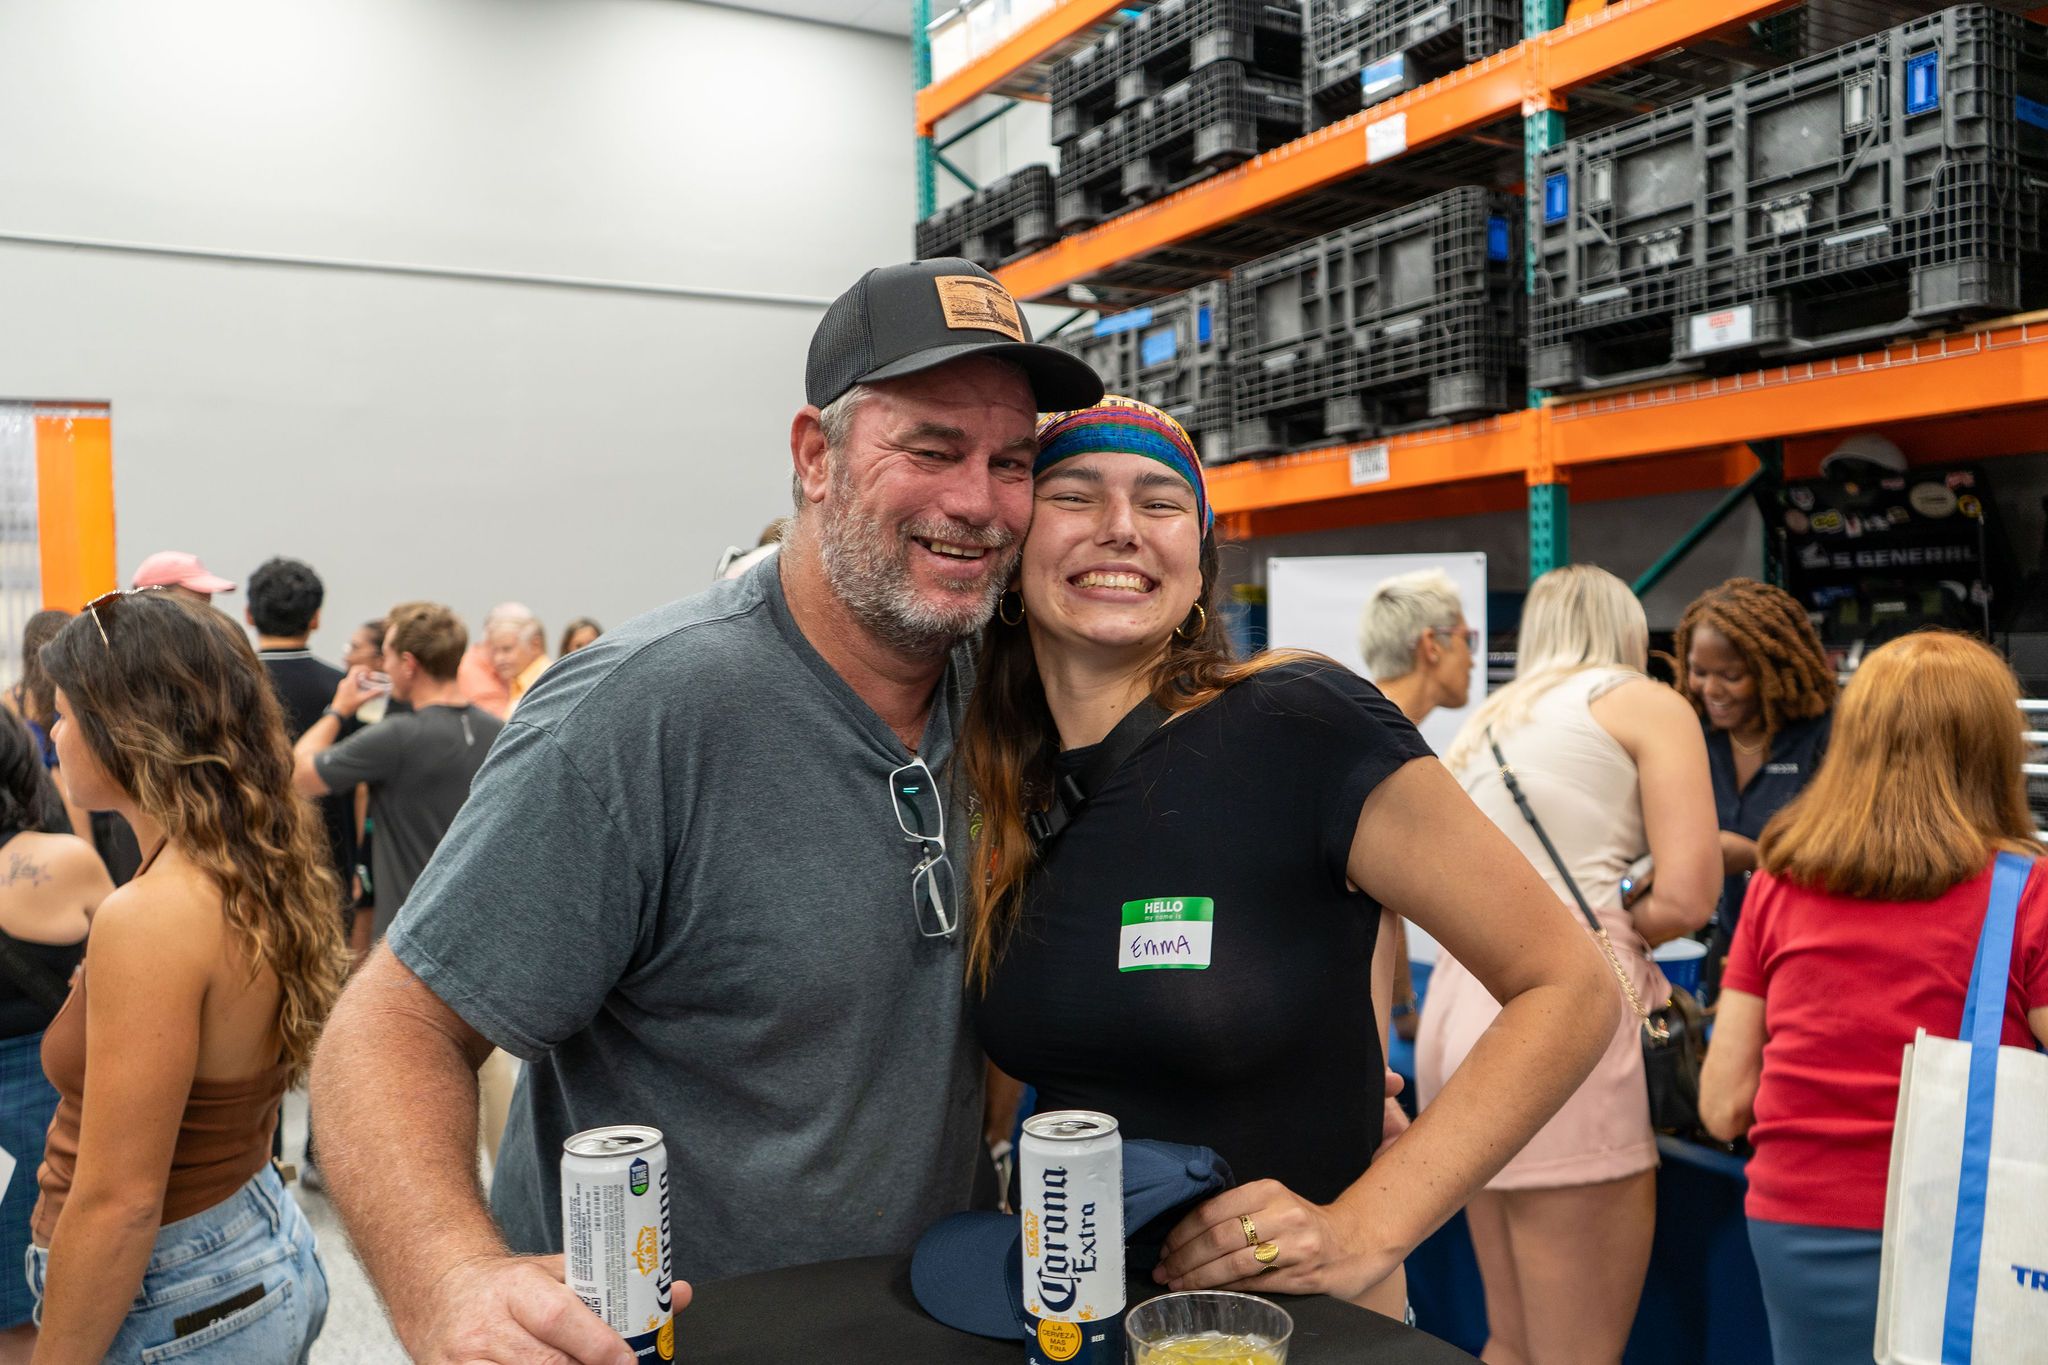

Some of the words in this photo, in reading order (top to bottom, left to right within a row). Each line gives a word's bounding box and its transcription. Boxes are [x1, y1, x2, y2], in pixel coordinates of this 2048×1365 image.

[1144, 901, 1183, 913] HELLO
[1037, 1166, 1082, 1313] Corona
[1071, 1201, 1097, 1276] Extra
[1042, 1330, 1076, 1339] CERVEZA
[1050, 1345, 1067, 1353] FINA
